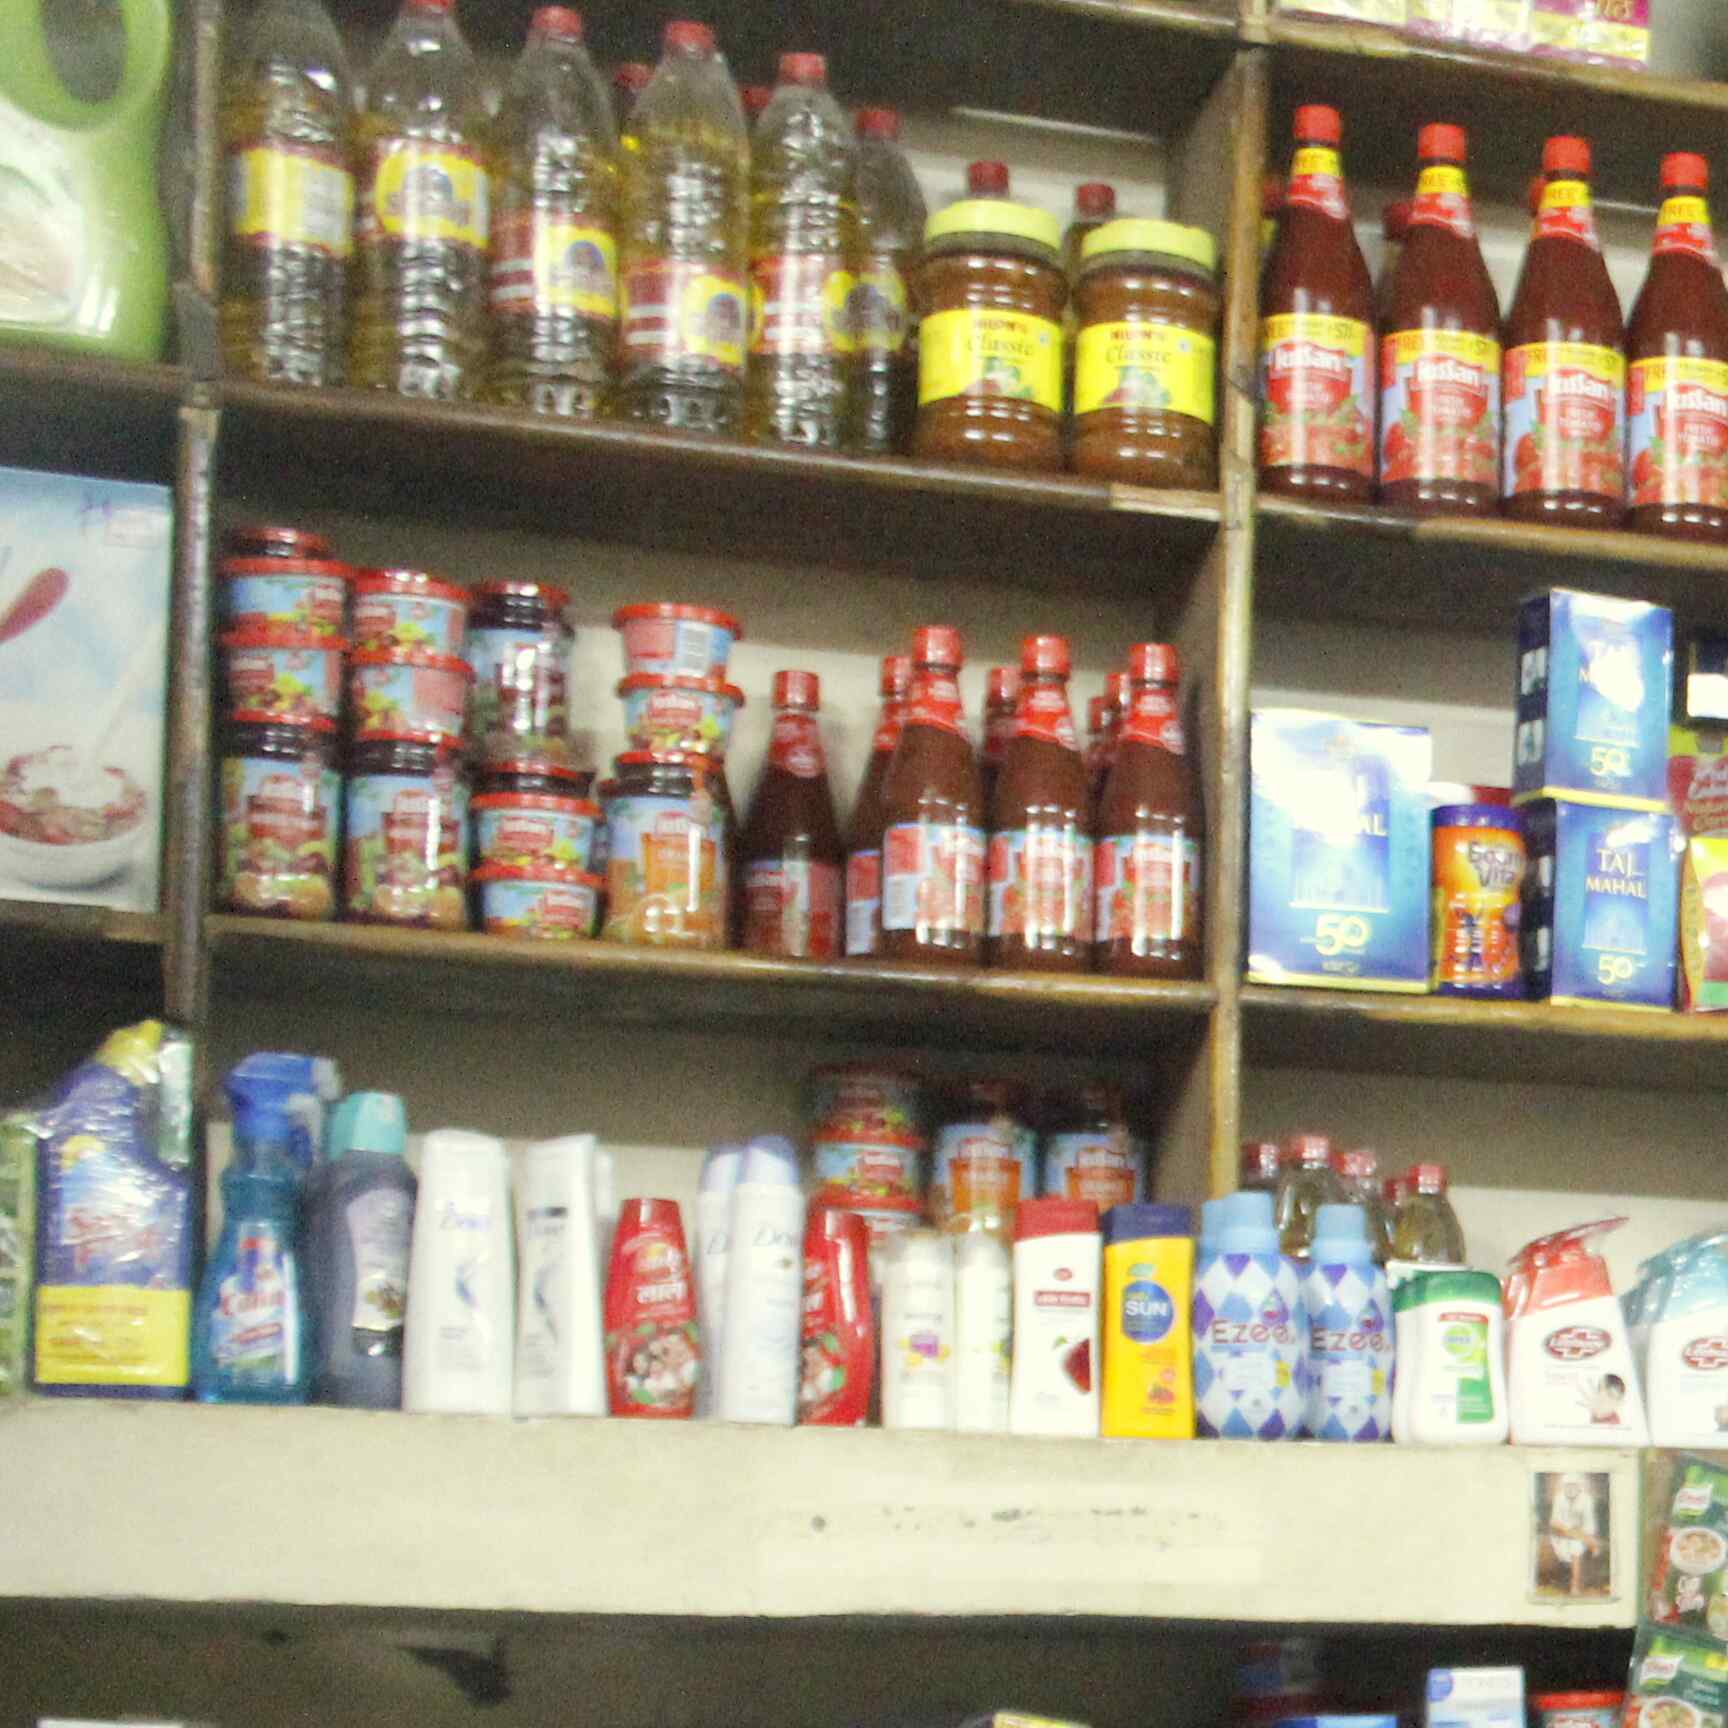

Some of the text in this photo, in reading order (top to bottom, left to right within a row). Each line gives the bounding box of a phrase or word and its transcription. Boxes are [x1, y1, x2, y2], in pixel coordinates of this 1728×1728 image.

[1598, 849, 1638, 878] TAJ
[1586, 877, 1648, 900] MAHAL
[1314, 911, 1372, 956] 50
[1597, 955, 1634, 985] 50
[1125, 1301, 1168, 1317] SUN
